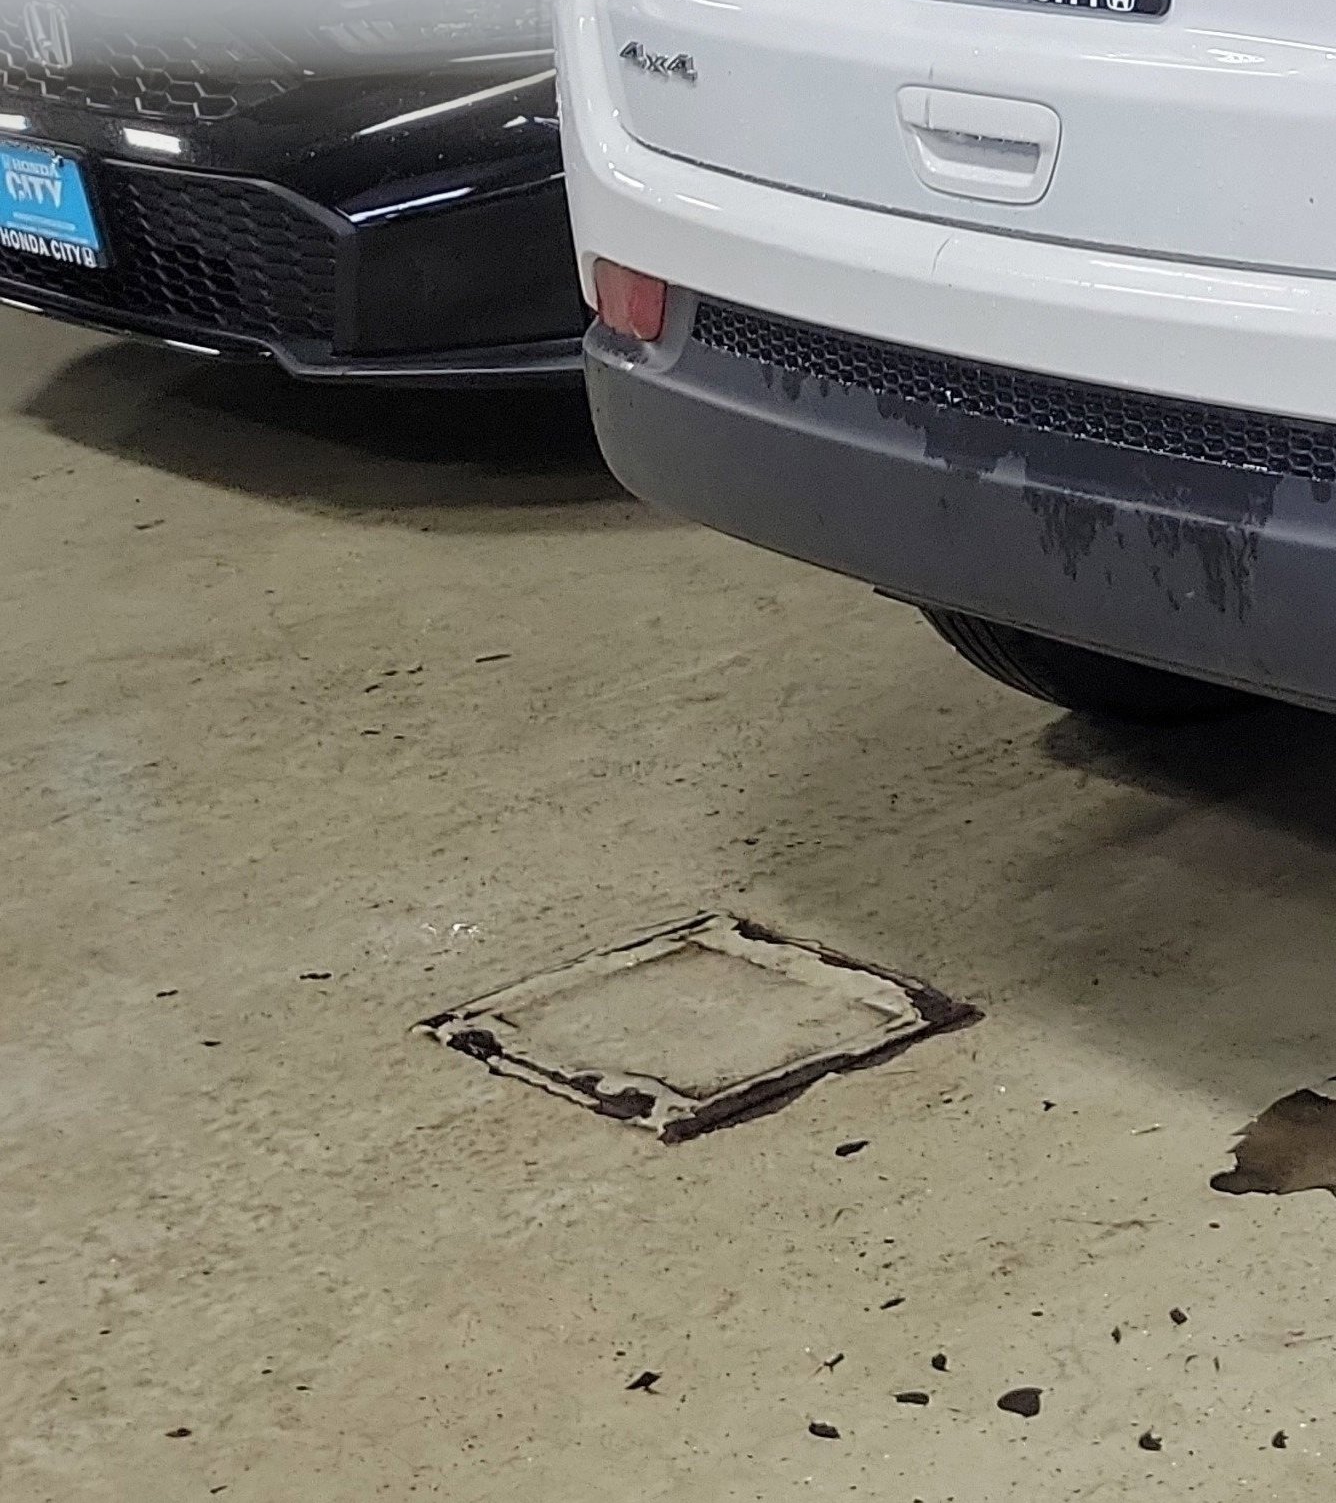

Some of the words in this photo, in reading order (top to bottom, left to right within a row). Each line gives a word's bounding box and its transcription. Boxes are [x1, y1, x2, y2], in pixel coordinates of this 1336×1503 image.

[6, 170, 62, 209] CITY
[0, 226, 51, 257] HONDA
[50, 239, 81, 265] CITY
